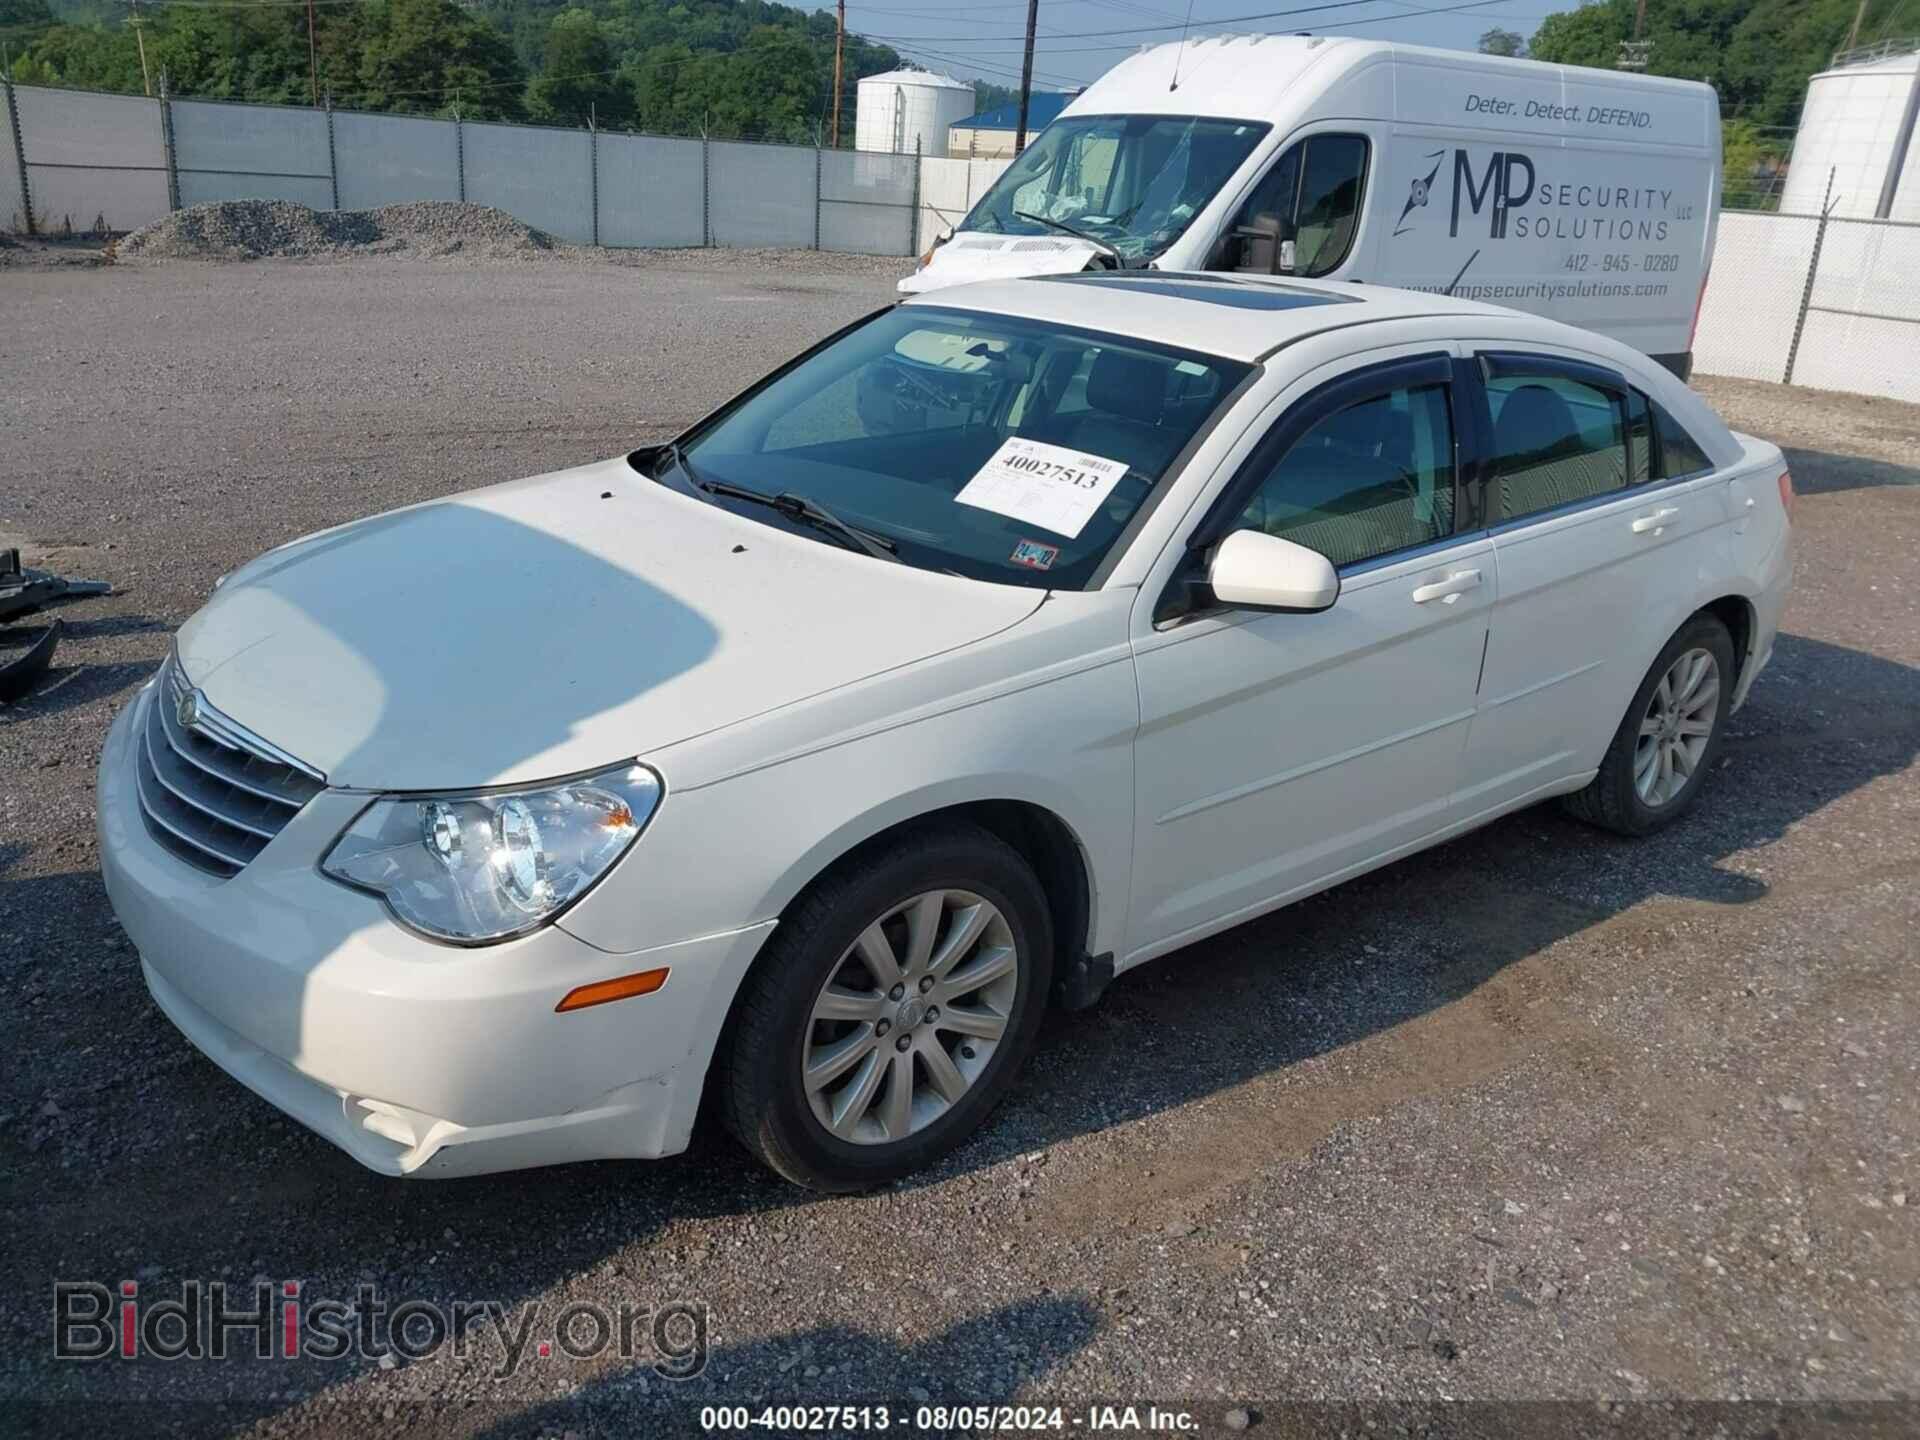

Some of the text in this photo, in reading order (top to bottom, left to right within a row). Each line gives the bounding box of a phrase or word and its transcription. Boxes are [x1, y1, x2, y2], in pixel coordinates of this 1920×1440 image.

[1465, 94, 1652, 128] Deter. Detect. DEFEND.
[1538, 183, 1672, 209] SECURITY
[1515, 216, 1668, 241] SOLUTIONS
[1003, 455, 1099, 489] 40027513
